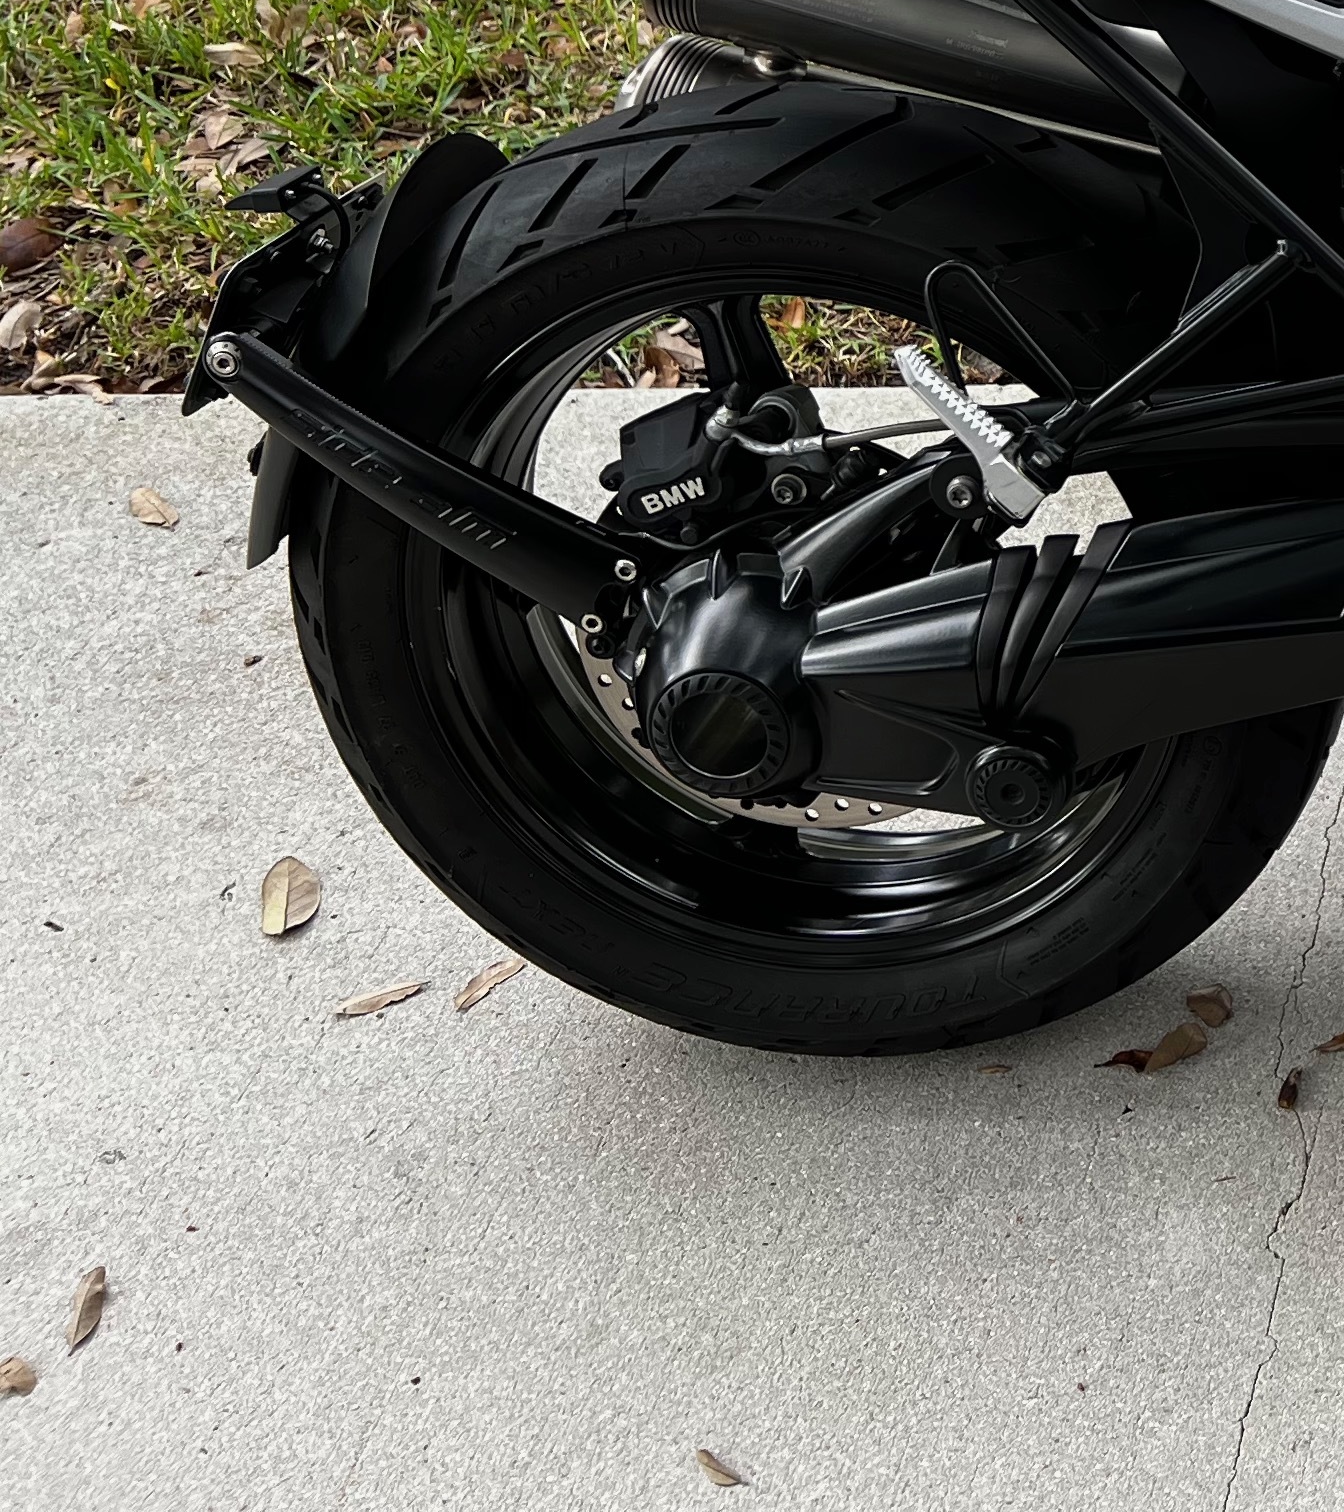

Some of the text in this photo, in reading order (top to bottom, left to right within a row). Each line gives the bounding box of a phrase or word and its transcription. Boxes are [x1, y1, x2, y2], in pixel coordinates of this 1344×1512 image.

[640, 476, 706, 515] BMW
[497, 883, 988, 1025] TOURANCE NEXT
